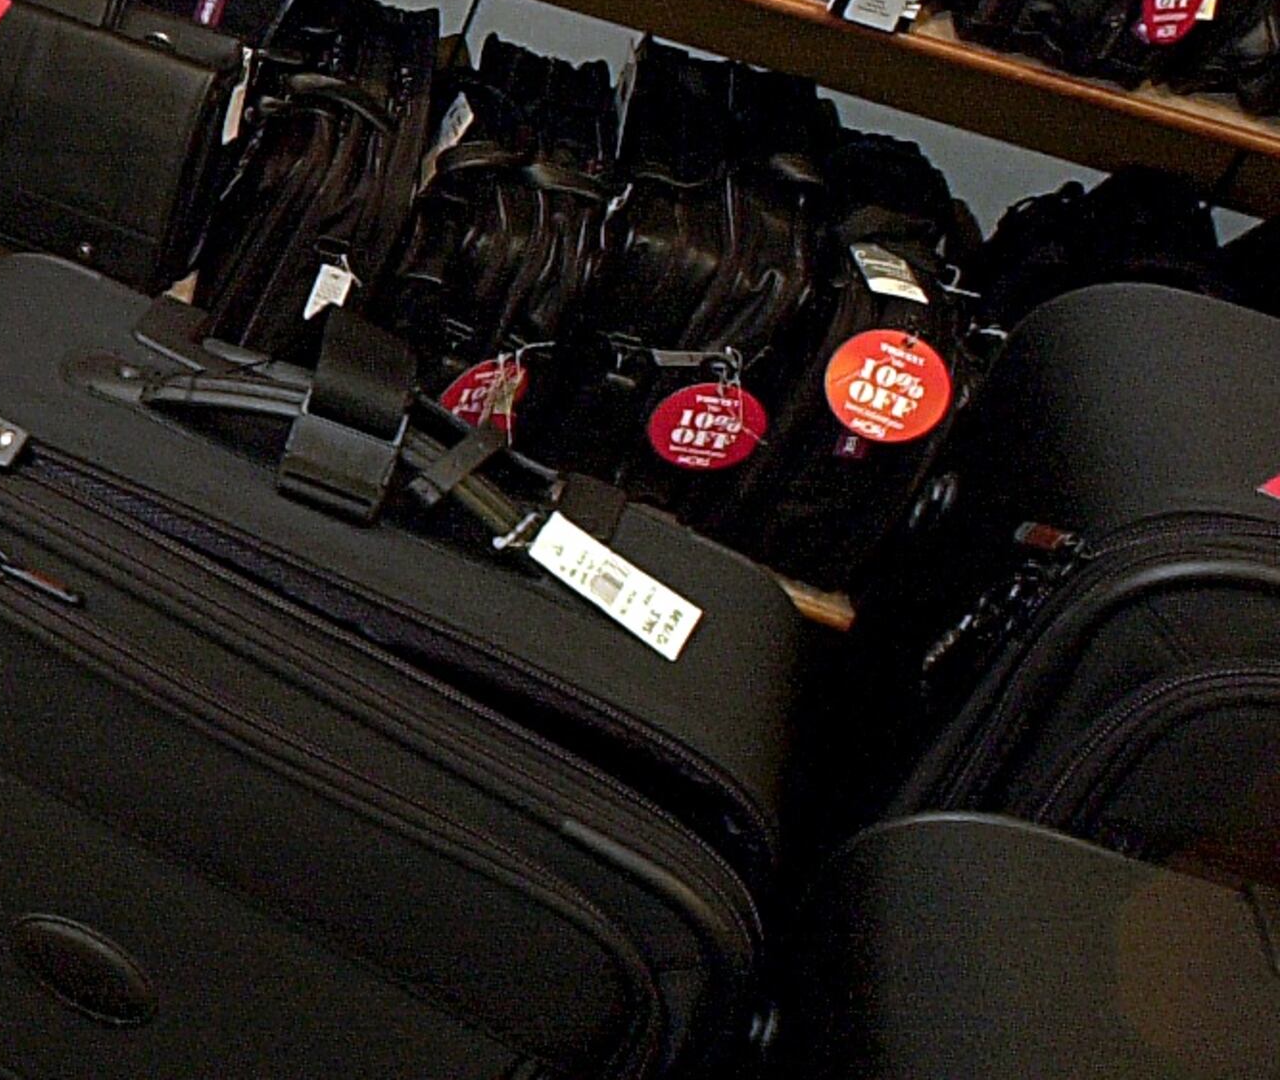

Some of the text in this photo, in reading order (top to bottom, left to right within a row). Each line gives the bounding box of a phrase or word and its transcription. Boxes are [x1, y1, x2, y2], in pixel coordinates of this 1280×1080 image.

[860, 358, 924, 399] 10%
[849, 380, 918, 418] OFF
[680, 409, 741, 433] 10%
[670, 427, 737, 450] OFF
